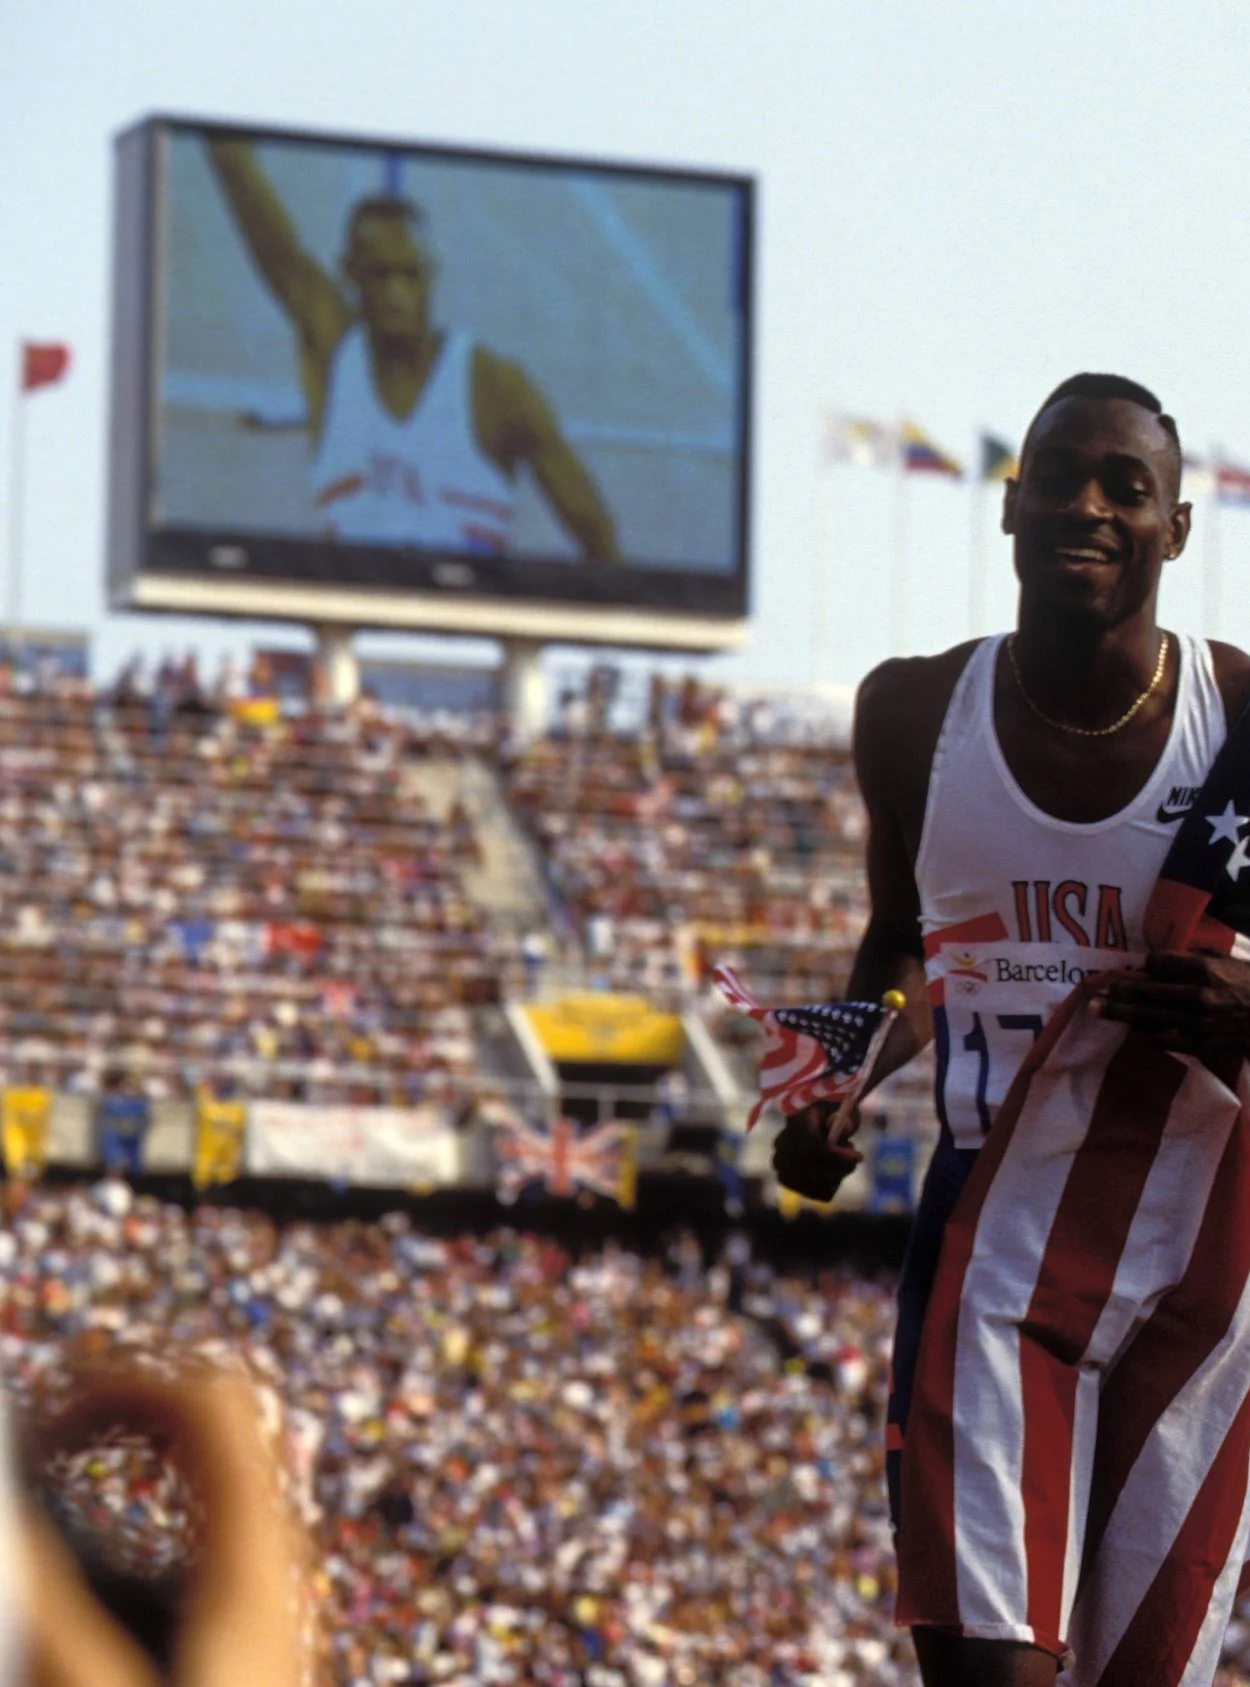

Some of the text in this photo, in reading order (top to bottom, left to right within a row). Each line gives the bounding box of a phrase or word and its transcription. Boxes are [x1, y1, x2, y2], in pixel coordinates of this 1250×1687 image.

[1167, 787, 1197, 807] NIK
[1012, 880, 1128, 952] USA
[996, 957, 1098, 985] Barcelo
